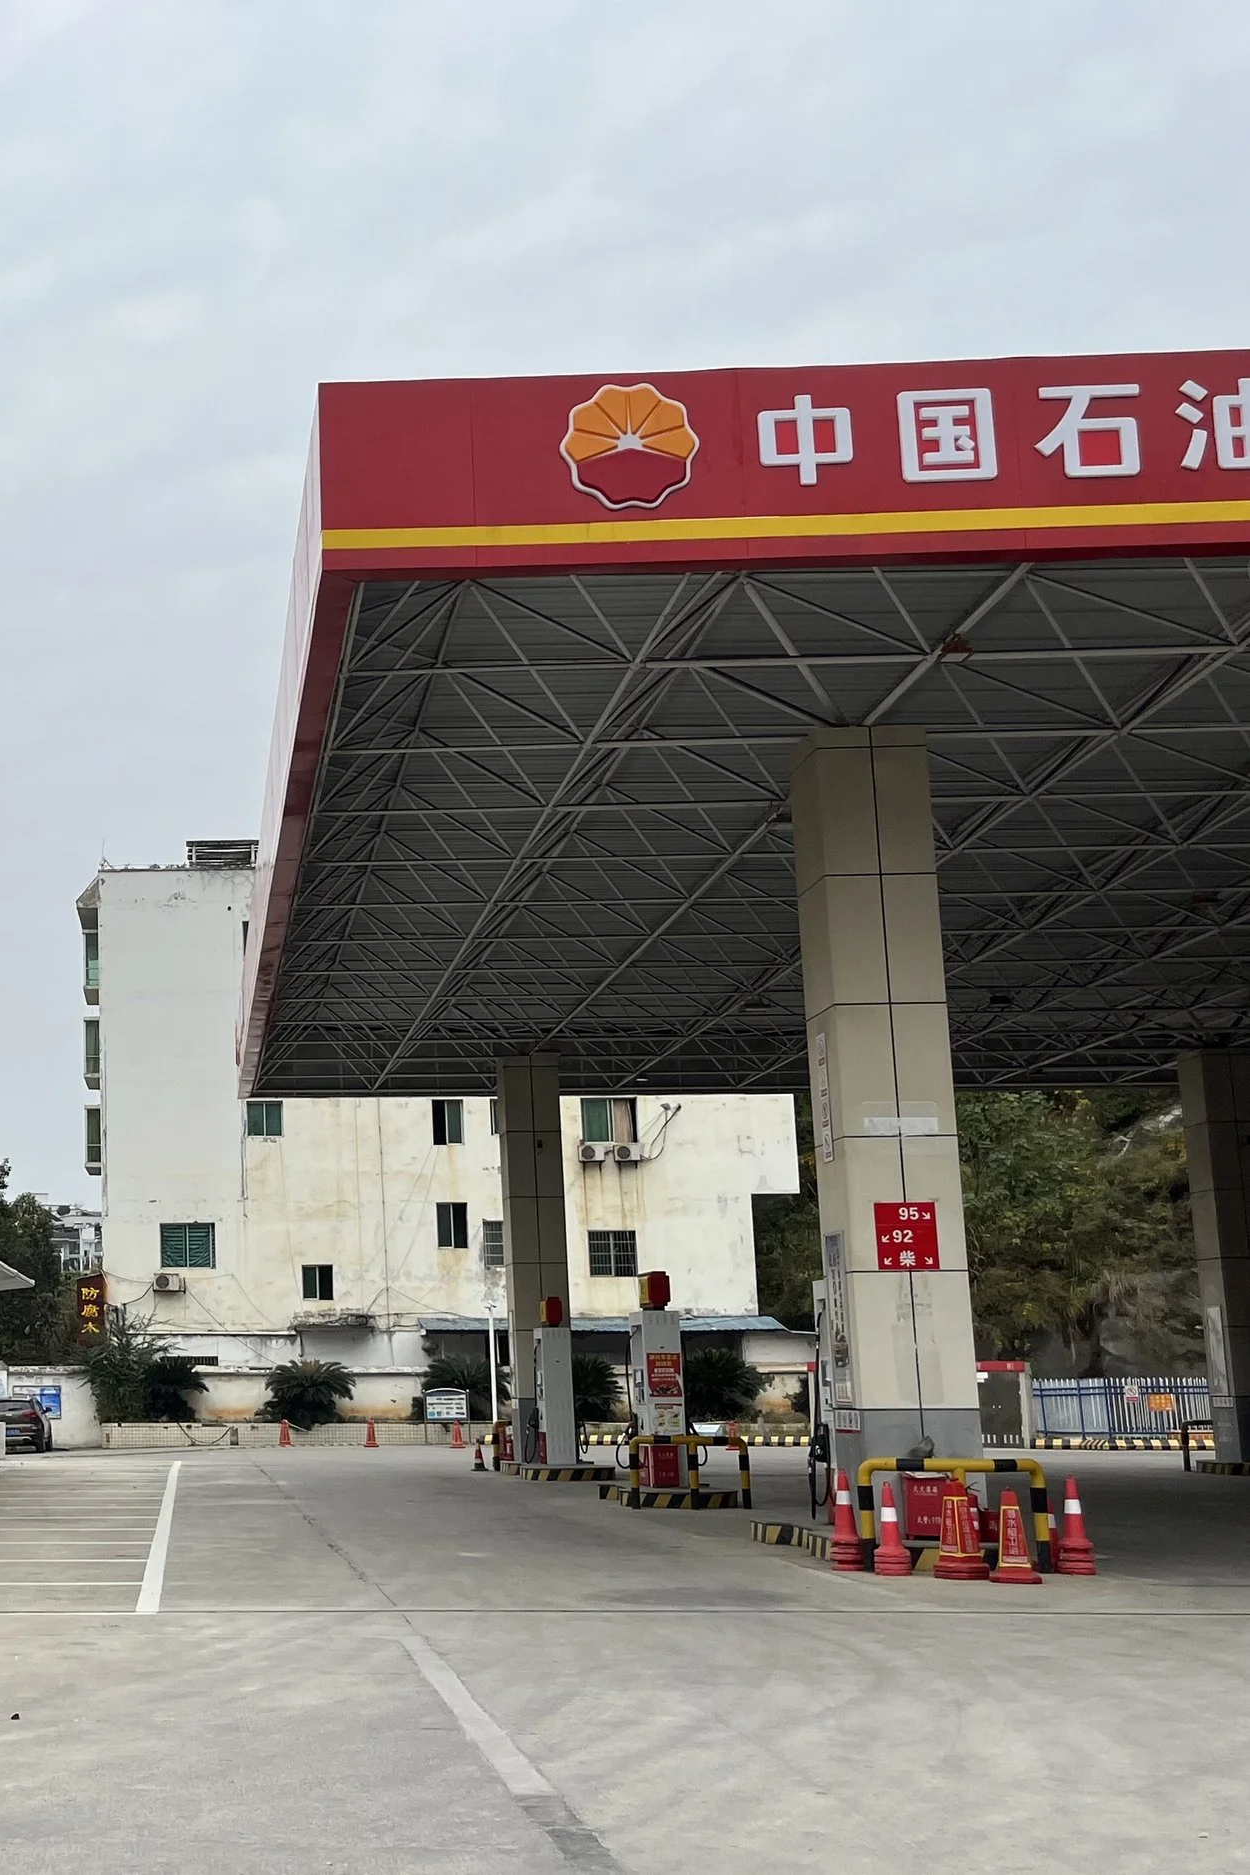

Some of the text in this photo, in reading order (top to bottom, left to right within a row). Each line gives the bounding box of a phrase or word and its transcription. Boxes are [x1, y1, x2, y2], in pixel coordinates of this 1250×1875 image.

[898, 1207, 920, 1221] 95
[892, 1229, 914, 1243] 92
[899, 1250, 916, 1267] 柴
[81, 1287, 100, 1334] 防腐木
